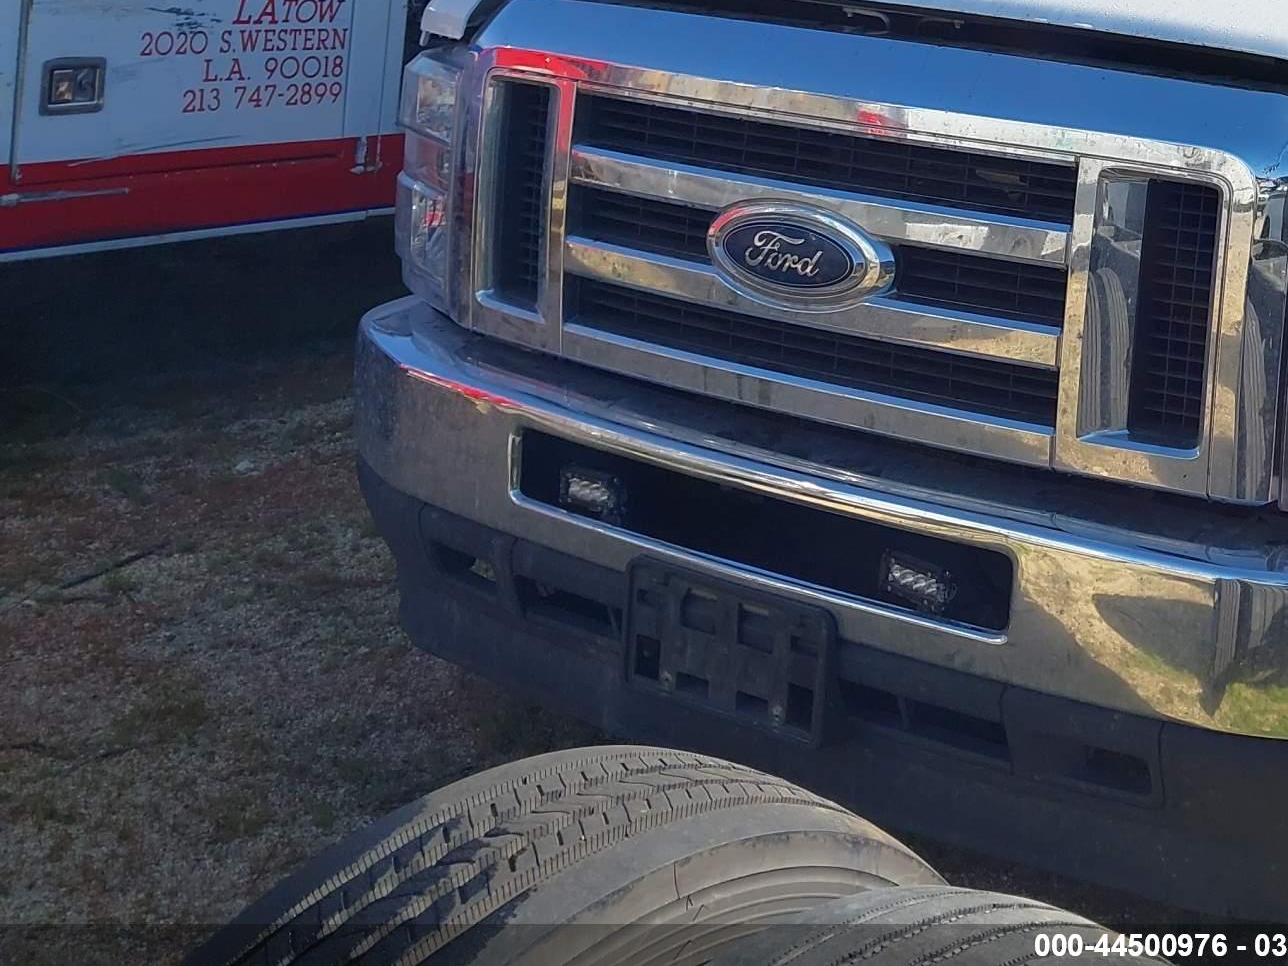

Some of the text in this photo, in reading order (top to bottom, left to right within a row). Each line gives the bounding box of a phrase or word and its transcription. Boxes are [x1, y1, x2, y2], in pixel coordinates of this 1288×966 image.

[140, 30, 209, 56] 2020
[203, 55, 344, 82] L.A. 90018
[182, 82, 342, 113] 213 747-2899
[745, 230, 824, 277] Ford
